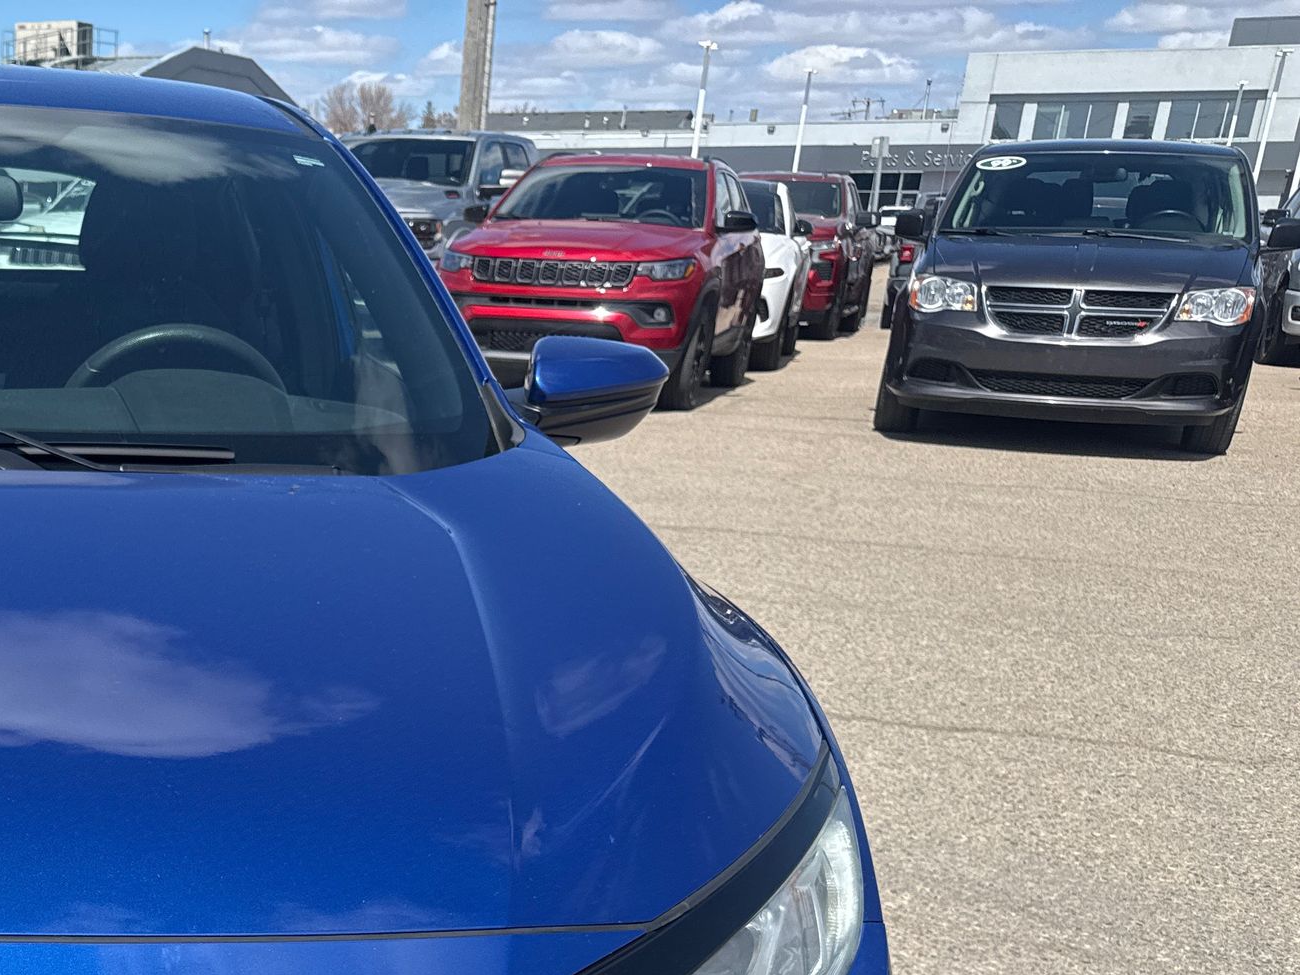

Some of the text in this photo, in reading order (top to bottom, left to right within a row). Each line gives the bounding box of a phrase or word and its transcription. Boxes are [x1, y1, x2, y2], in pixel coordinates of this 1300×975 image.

[861, 150, 899, 167] Pats
[904, 150, 917, 167] &
[922, 150, 974, 167] Servic
